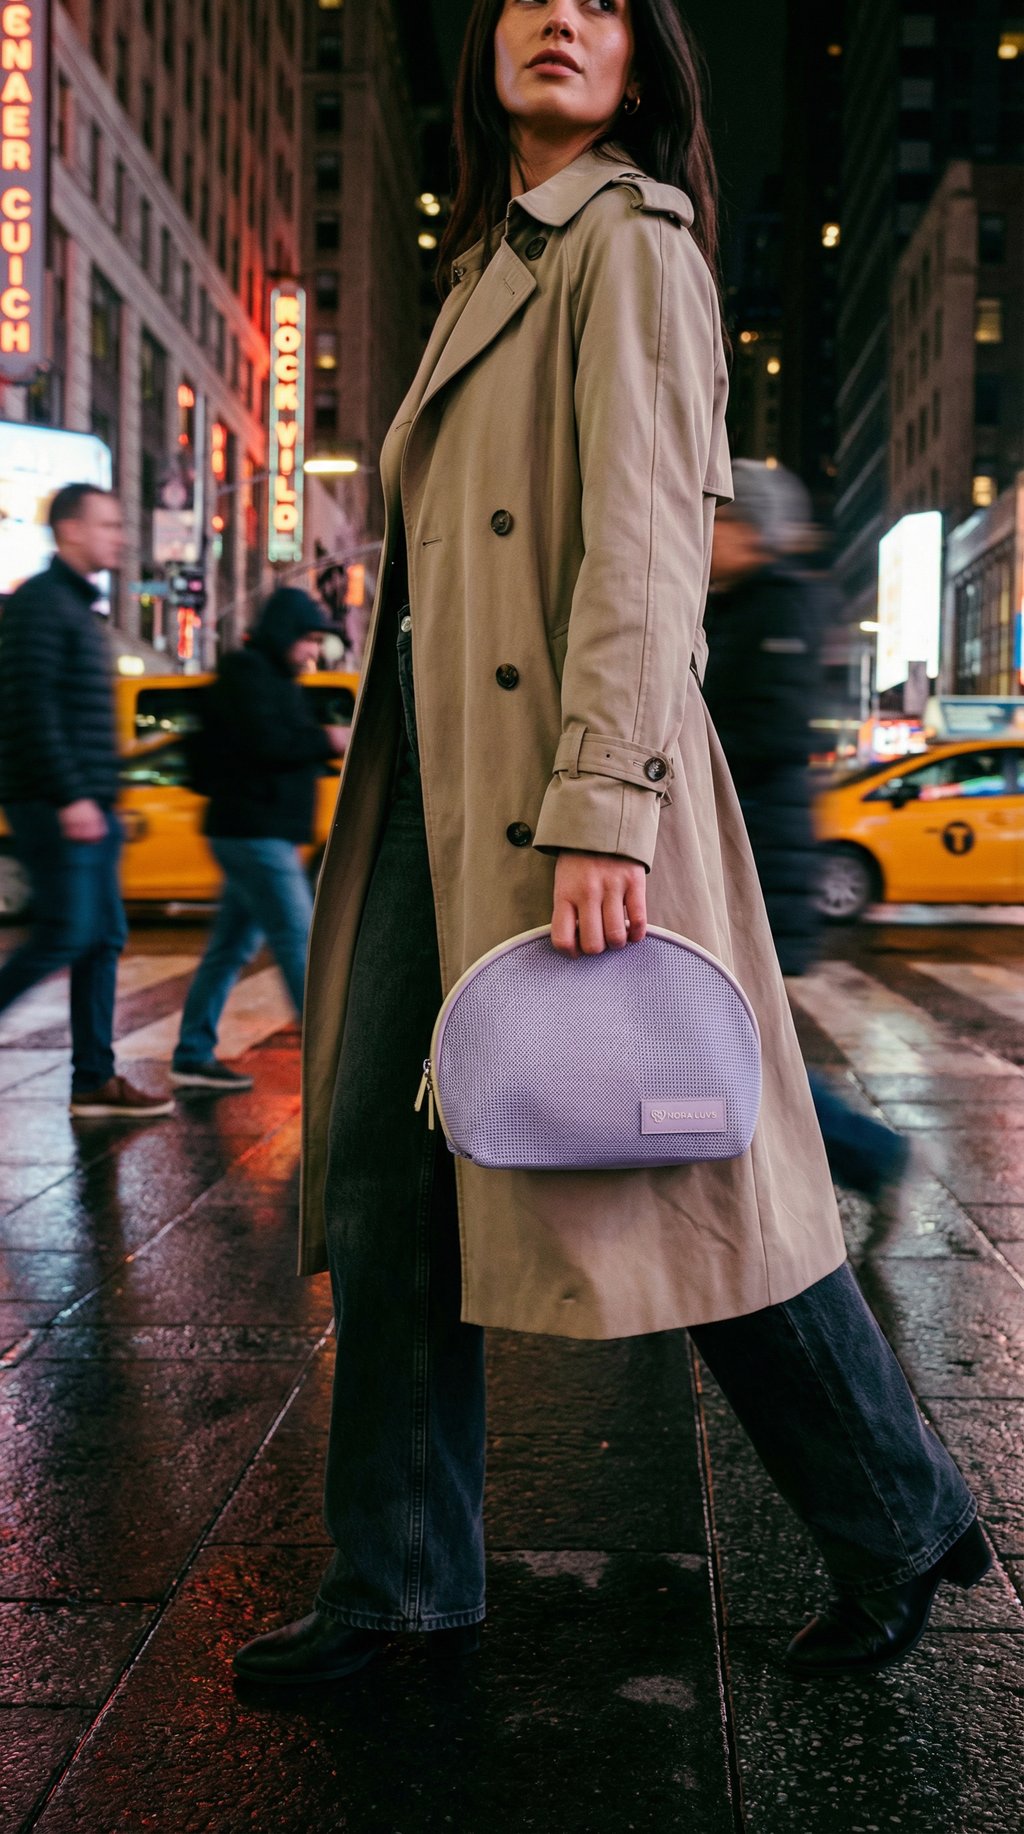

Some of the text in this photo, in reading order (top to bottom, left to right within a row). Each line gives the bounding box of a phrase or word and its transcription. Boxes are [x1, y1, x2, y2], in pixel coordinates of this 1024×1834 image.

[1, 0, 33, 353] ENAER CUICH
[274, 296, 301, 411] ROCK
[667, 1110, 718, 1120] NORA LUVS
